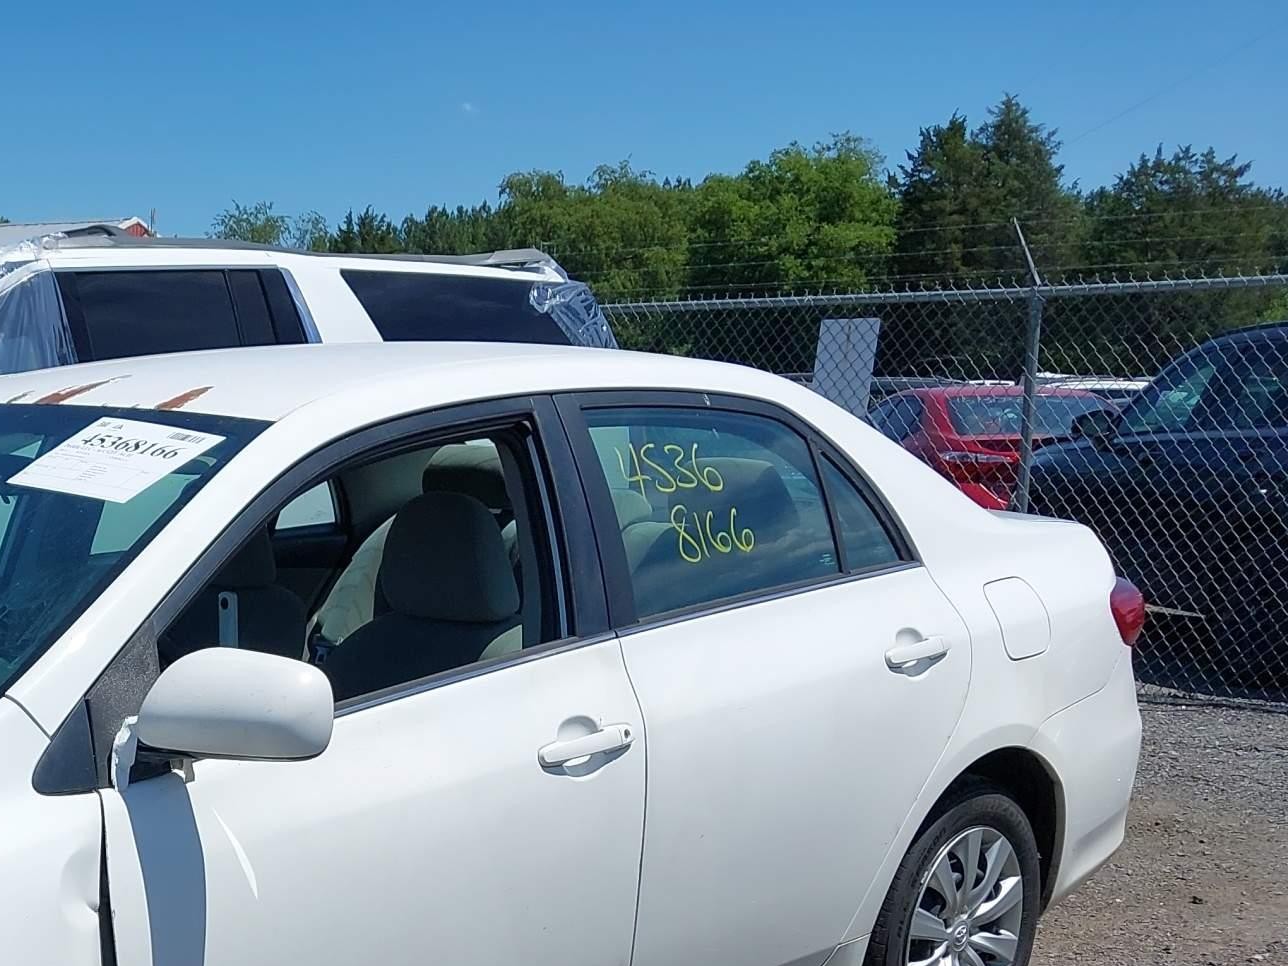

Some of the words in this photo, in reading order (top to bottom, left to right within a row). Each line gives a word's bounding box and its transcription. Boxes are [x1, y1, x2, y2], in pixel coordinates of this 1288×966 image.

[81, 432, 184, 460] 45368166
[614, 443, 724, 513] 4536
[670, 504, 755, 563] 8166
